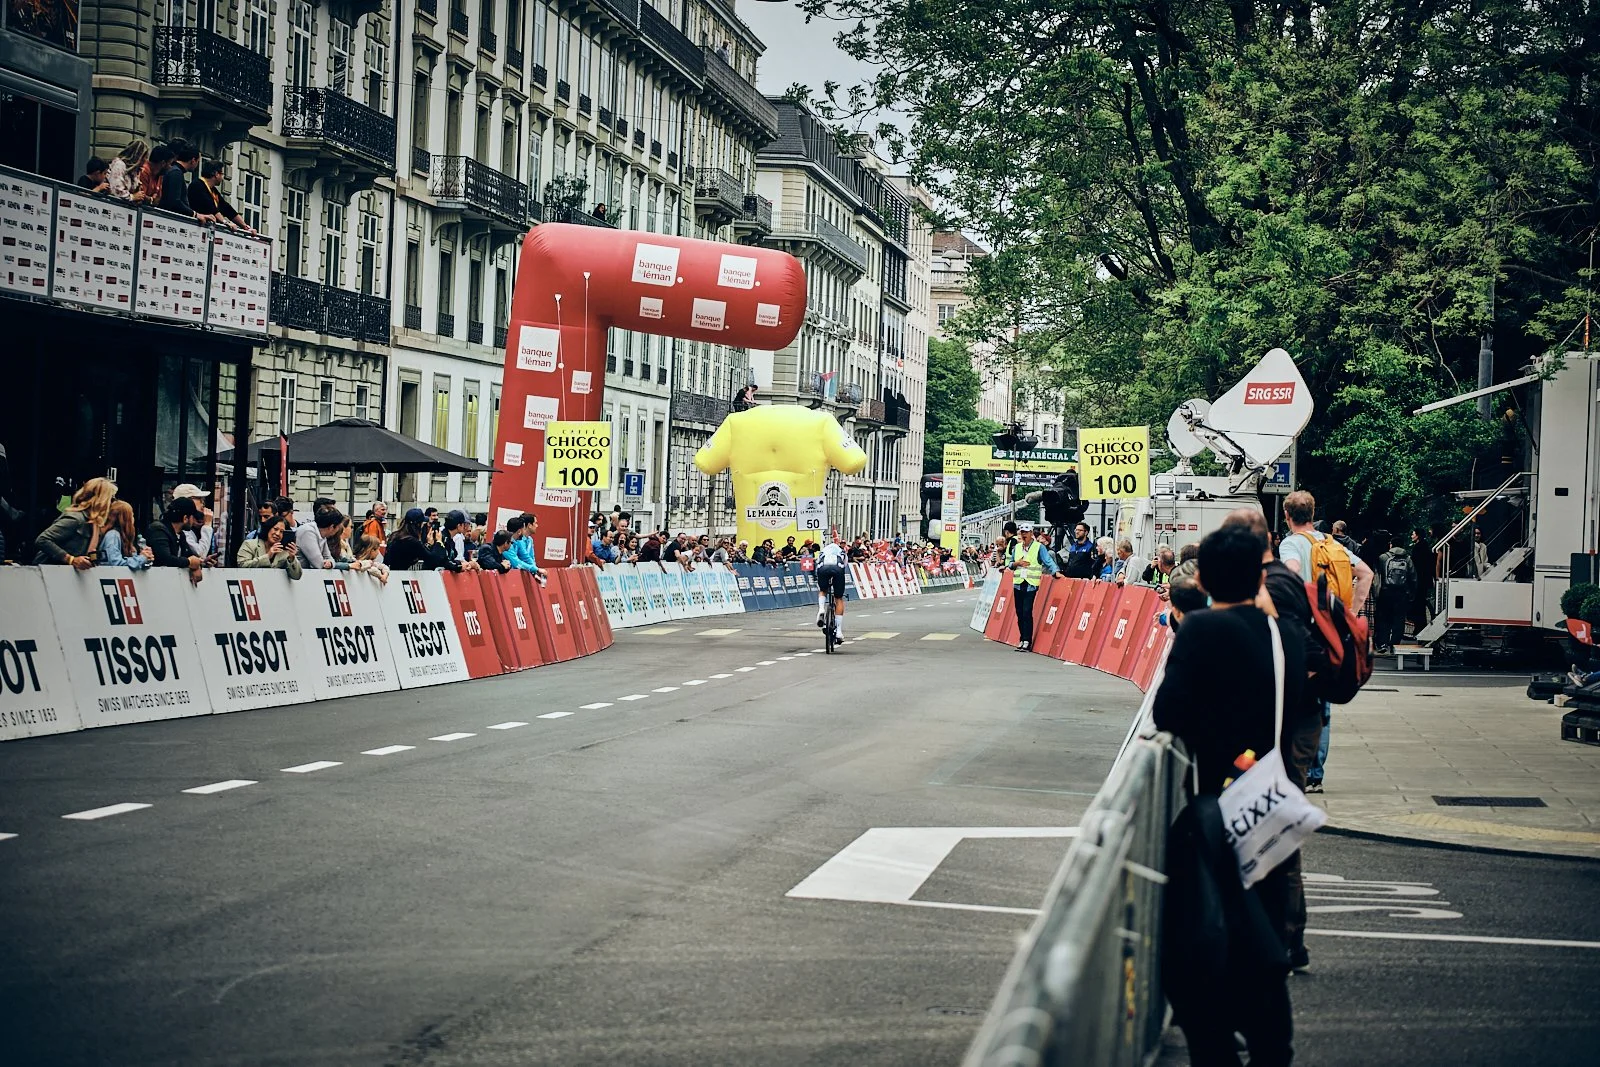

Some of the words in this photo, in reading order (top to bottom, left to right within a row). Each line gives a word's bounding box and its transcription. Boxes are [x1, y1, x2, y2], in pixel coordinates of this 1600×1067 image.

[639, 260, 672, 272] banque
[643, 271, 671, 282] léman
[723, 268, 751, 278] banque
[727, 276, 750, 285] léman
[695, 313, 721, 322] banque
[522, 346, 552, 358] banque
[525, 357, 551, 367] léman
[1248, 388, 1271, 400] SRG
[1272, 387, 1292, 399] SSR
[528, 411, 553, 419] banque
[547, 436, 610, 447] CHICCO
[1084, 441, 1143, 454] CHICCO
[553, 449, 603, 459] D'ORO
[1022, 450, 1068, 460] MARÉCHAL
[1090, 454, 1139, 466] D'ORO
[559, 467, 598, 486] 100
[1094, 474, 1136, 494] 100
[546, 493, 572, 502] léman
[758, 508, 796, 517] MARÉCHA
[807, 519, 819, 528] 50
[464, 611, 481, 635] RTS
[316, 625, 378, 666] TISSOT
[398, 621, 450, 658] TISSOT
[214, 630, 290, 676] TISSOT
[84, 635, 180, 686] TISSOT
[227, 686, 245, 699] SWISS
[246, 683, 271, 696] WATCHES
[270, 681, 286, 694] SINCE
[287, 680, 299, 692] 1853
[98, 696, 121, 712] SWISS
[121, 693, 154, 710] WATCHES
[155, 692, 175, 707] SINCE
[175, 690, 190, 704] 1853
[10, 709, 36, 726] SINCE
[38, 707, 57, 722] 1853
